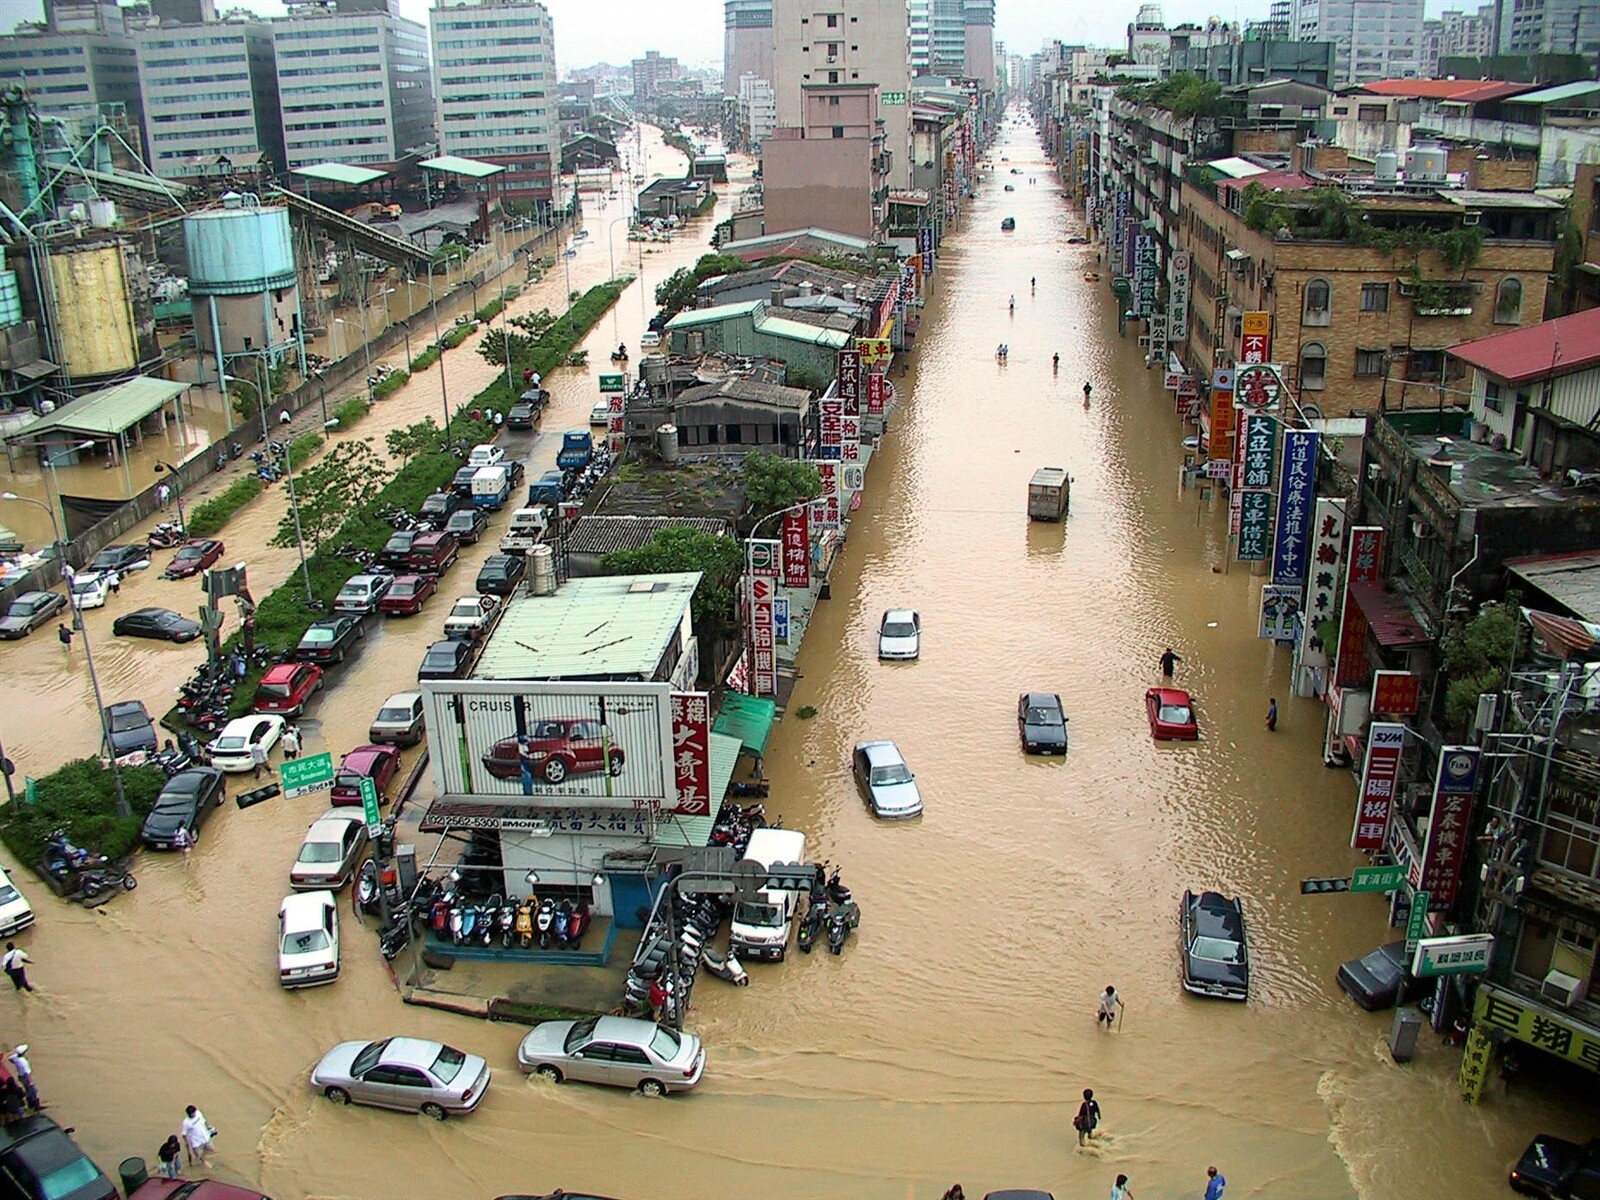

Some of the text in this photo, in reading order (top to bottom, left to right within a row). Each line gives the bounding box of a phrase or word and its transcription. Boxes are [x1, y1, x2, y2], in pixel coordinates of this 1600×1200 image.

[857, 341, 888, 358] 租車
[842, 420, 858, 460] 輪胎
[1278, 434, 1309, 577] 仙道民俗療法推拿中心
[469, 701, 531, 712] CRUISR
[1374, 732, 1402, 743] SYM
[288, 758, 326, 774] 市民大道
[1451, 760, 1470, 770] FINA
[1359, 757, 1396, 839] 三陽機車
